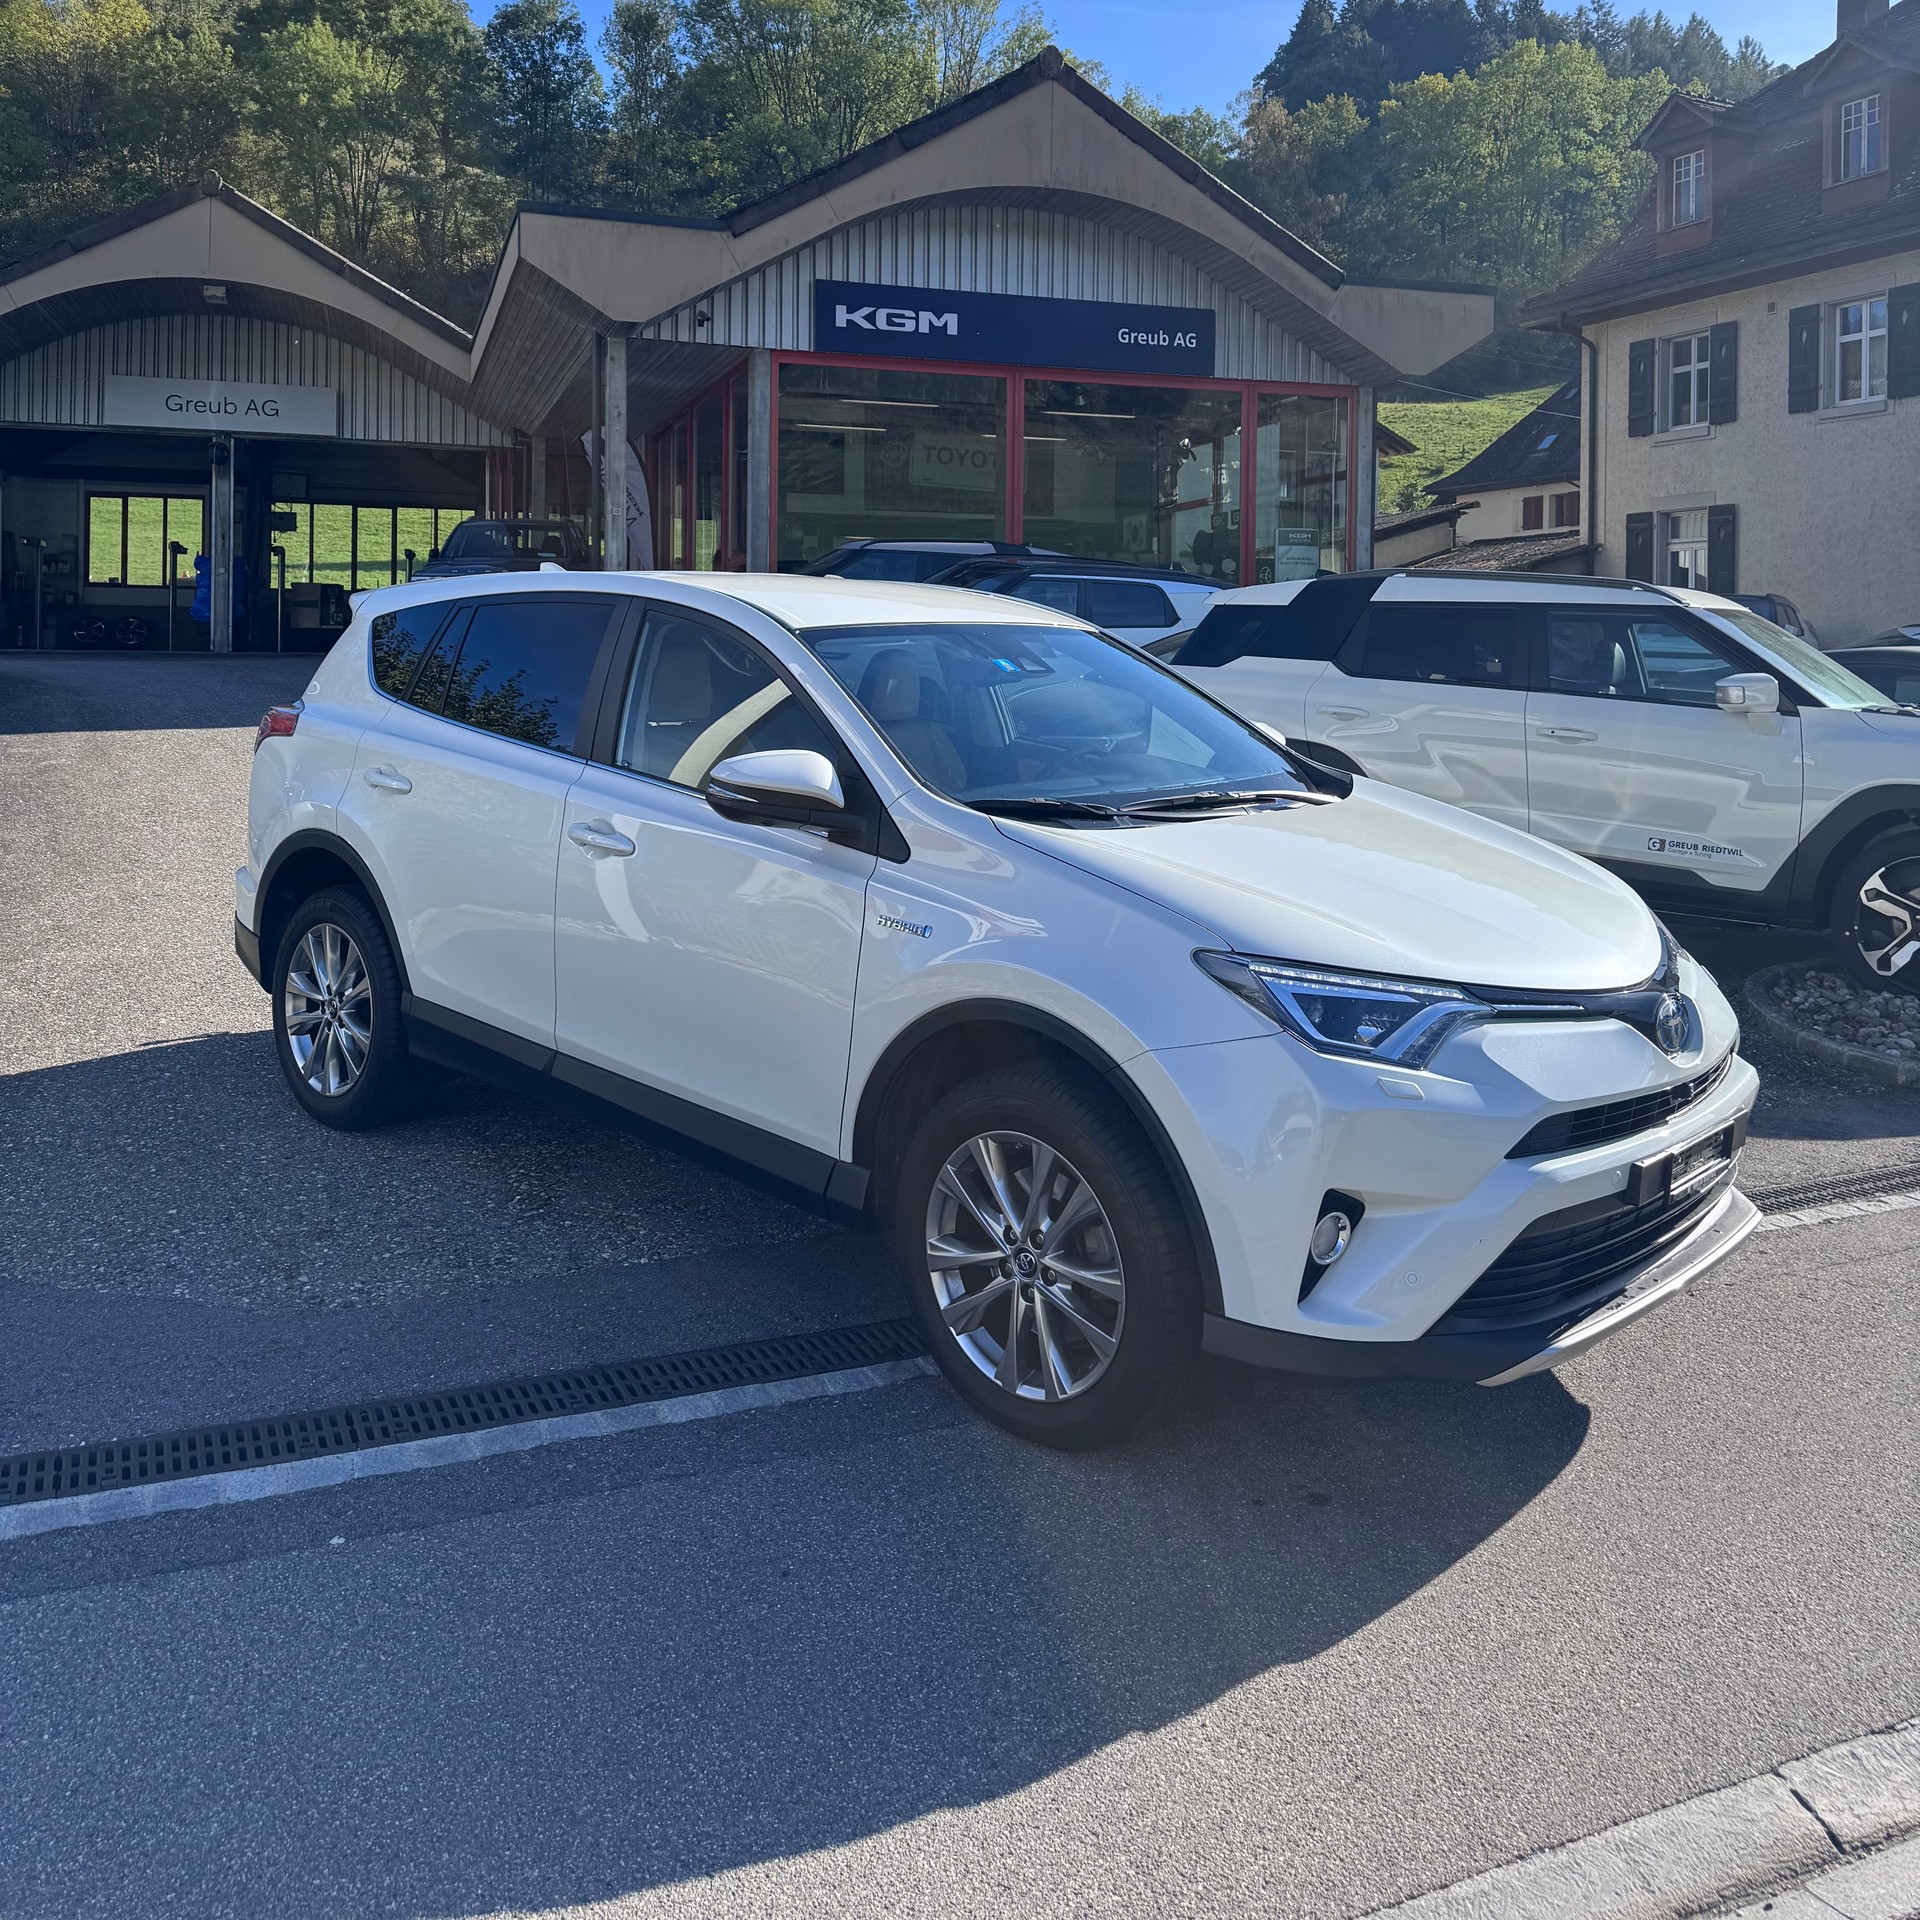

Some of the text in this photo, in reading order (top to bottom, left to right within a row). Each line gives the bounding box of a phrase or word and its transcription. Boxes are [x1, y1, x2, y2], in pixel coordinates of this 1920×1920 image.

[835, 304, 958, 336] KGM
[1118, 328, 1197, 348] Greub AG
[165, 394, 279, 417] Greub AG
[923, 444, 996, 470] TOYOT
[1668, 841, 1743, 856] GREUB RIEDTWIL
